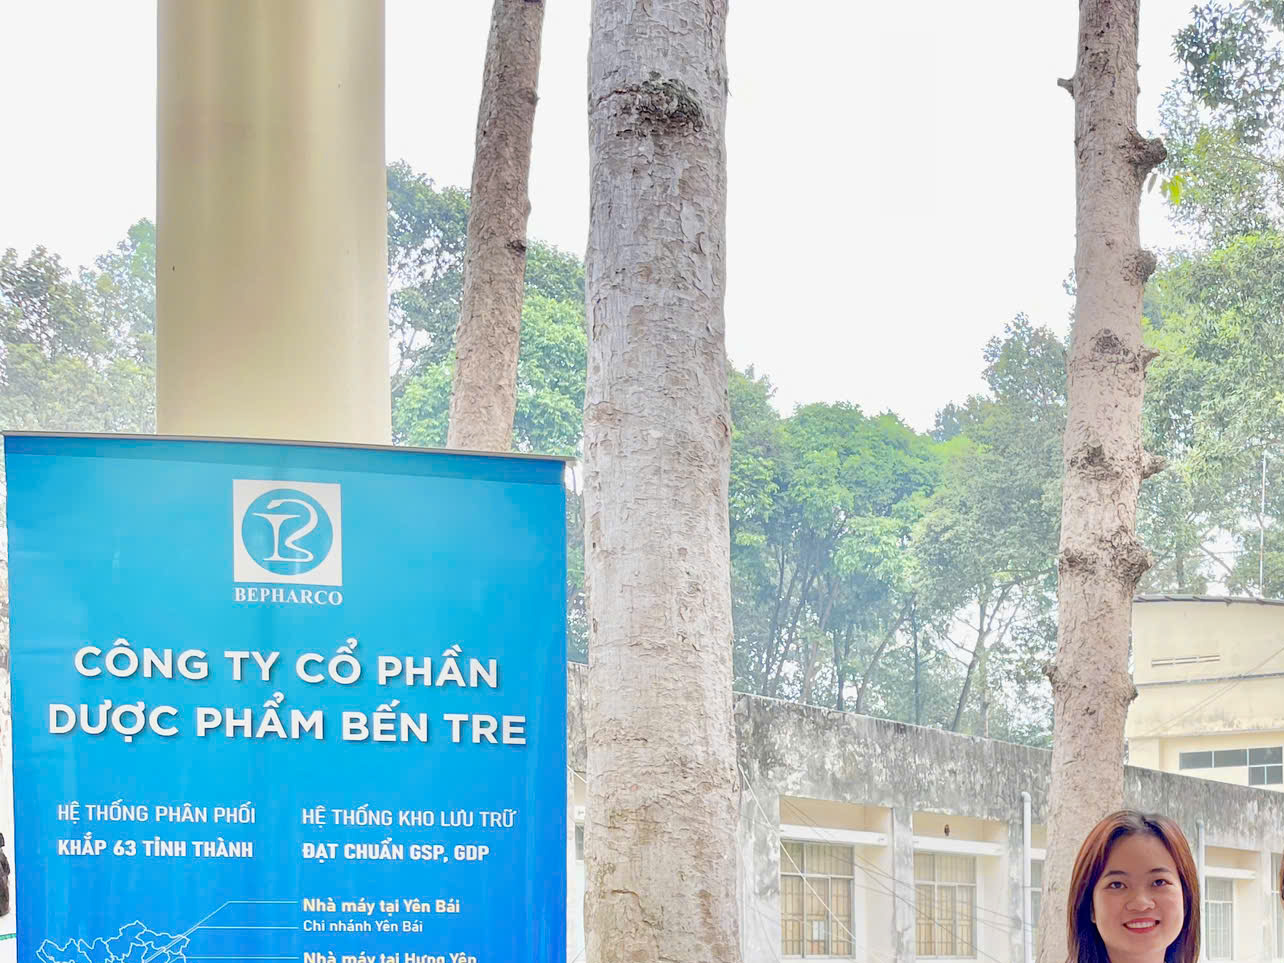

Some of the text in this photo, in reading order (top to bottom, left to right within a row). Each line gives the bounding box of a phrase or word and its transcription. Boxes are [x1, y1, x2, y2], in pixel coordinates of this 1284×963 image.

[234, 587, 343, 606] BEPHARCO
[74, 637, 499, 688] CÔNG TY CỔ PHẦN
[48, 691, 526, 745] DƯỢC PHẨM BẾN TRE
[57, 798, 256, 825] HỆ THỐNG PHÂN PHỐI
[301, 803, 517, 828] HỆ THỐNG KHO LƯU TRỮ
[57, 831, 107, 856] KHẮP
[112, 839, 137, 856] 63
[191, 836, 253, 858] THÀNH
[302, 837, 490, 864] ĐẠT CHUẨN GSP, GDP
[303, 897, 460, 917] Nhà máy tại Yên Bái
[303, 919, 423, 932] Chi nhánh Yên Bái
